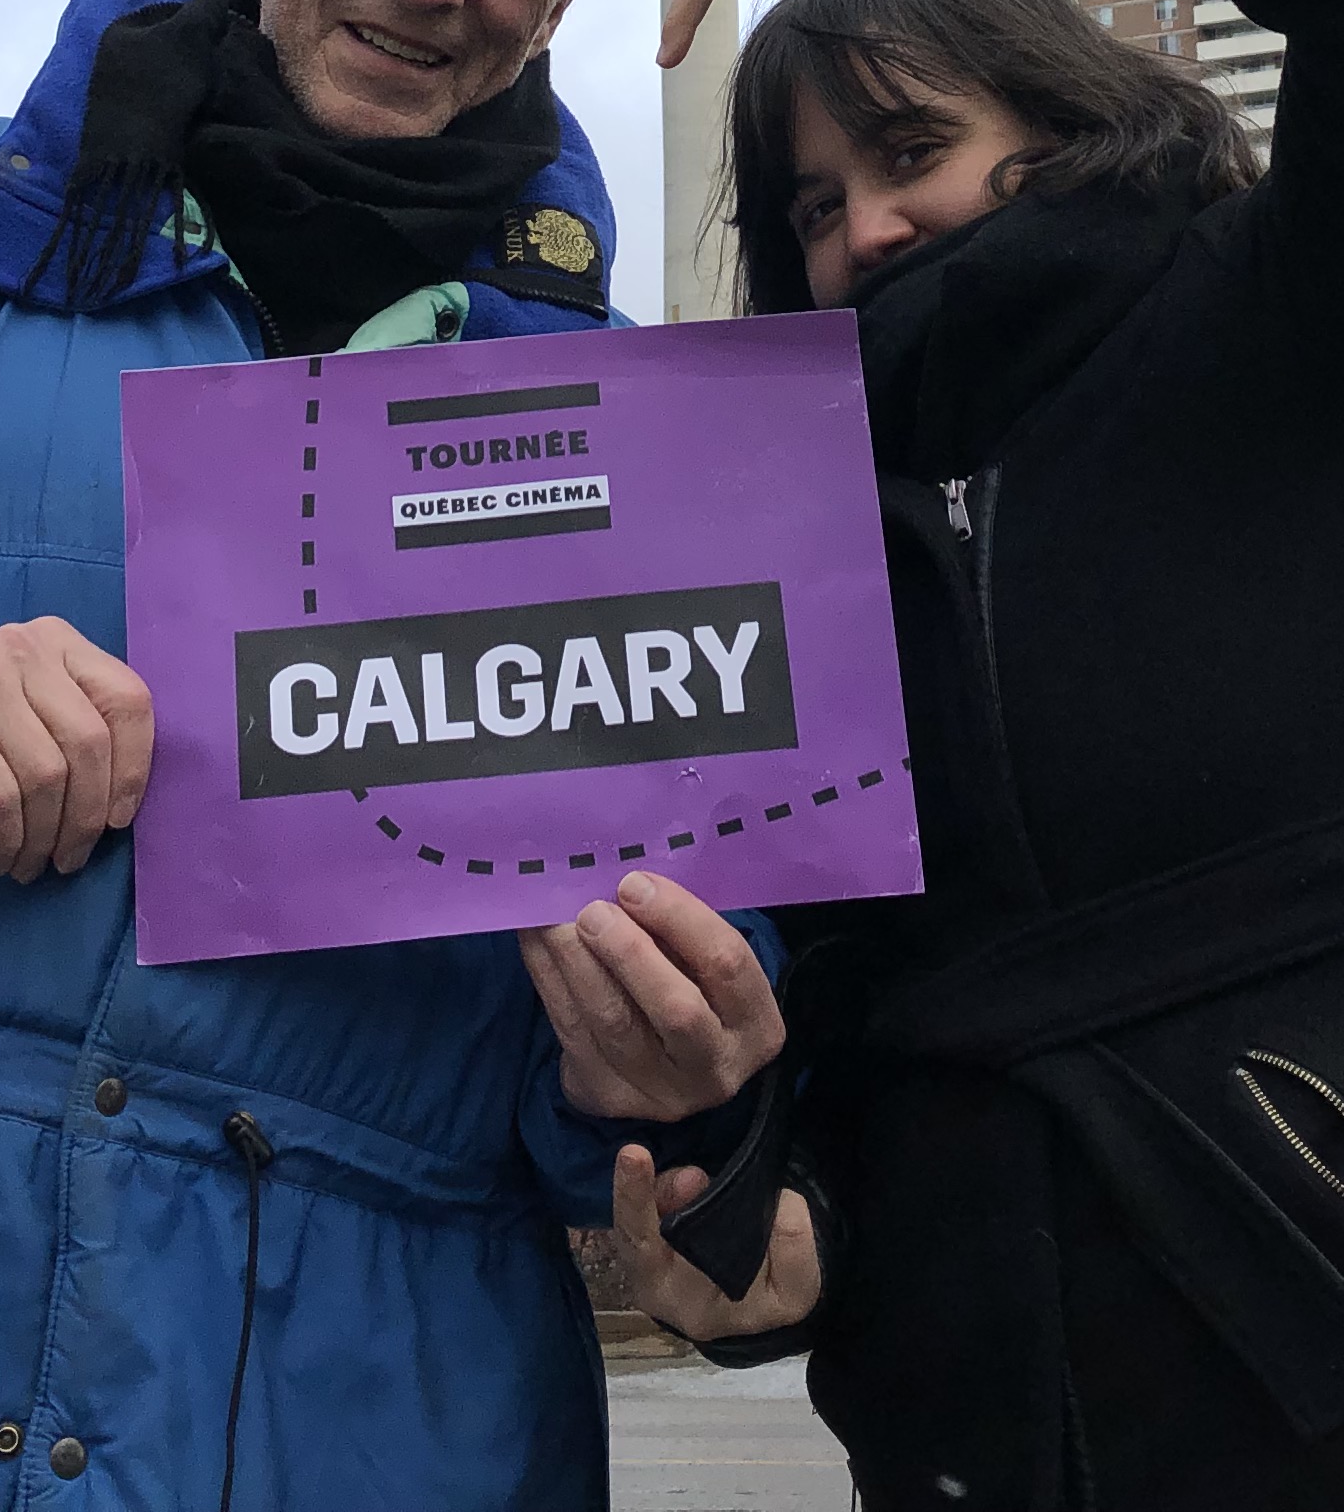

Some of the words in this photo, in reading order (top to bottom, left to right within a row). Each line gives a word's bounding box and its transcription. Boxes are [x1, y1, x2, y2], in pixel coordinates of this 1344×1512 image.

[406, 430, 590, 472] TOURNÉE
[400, 494, 498, 520] QUÉBEC
[505, 484, 602, 508] CINÉMA
[269, 620, 761, 757] CALGARY
